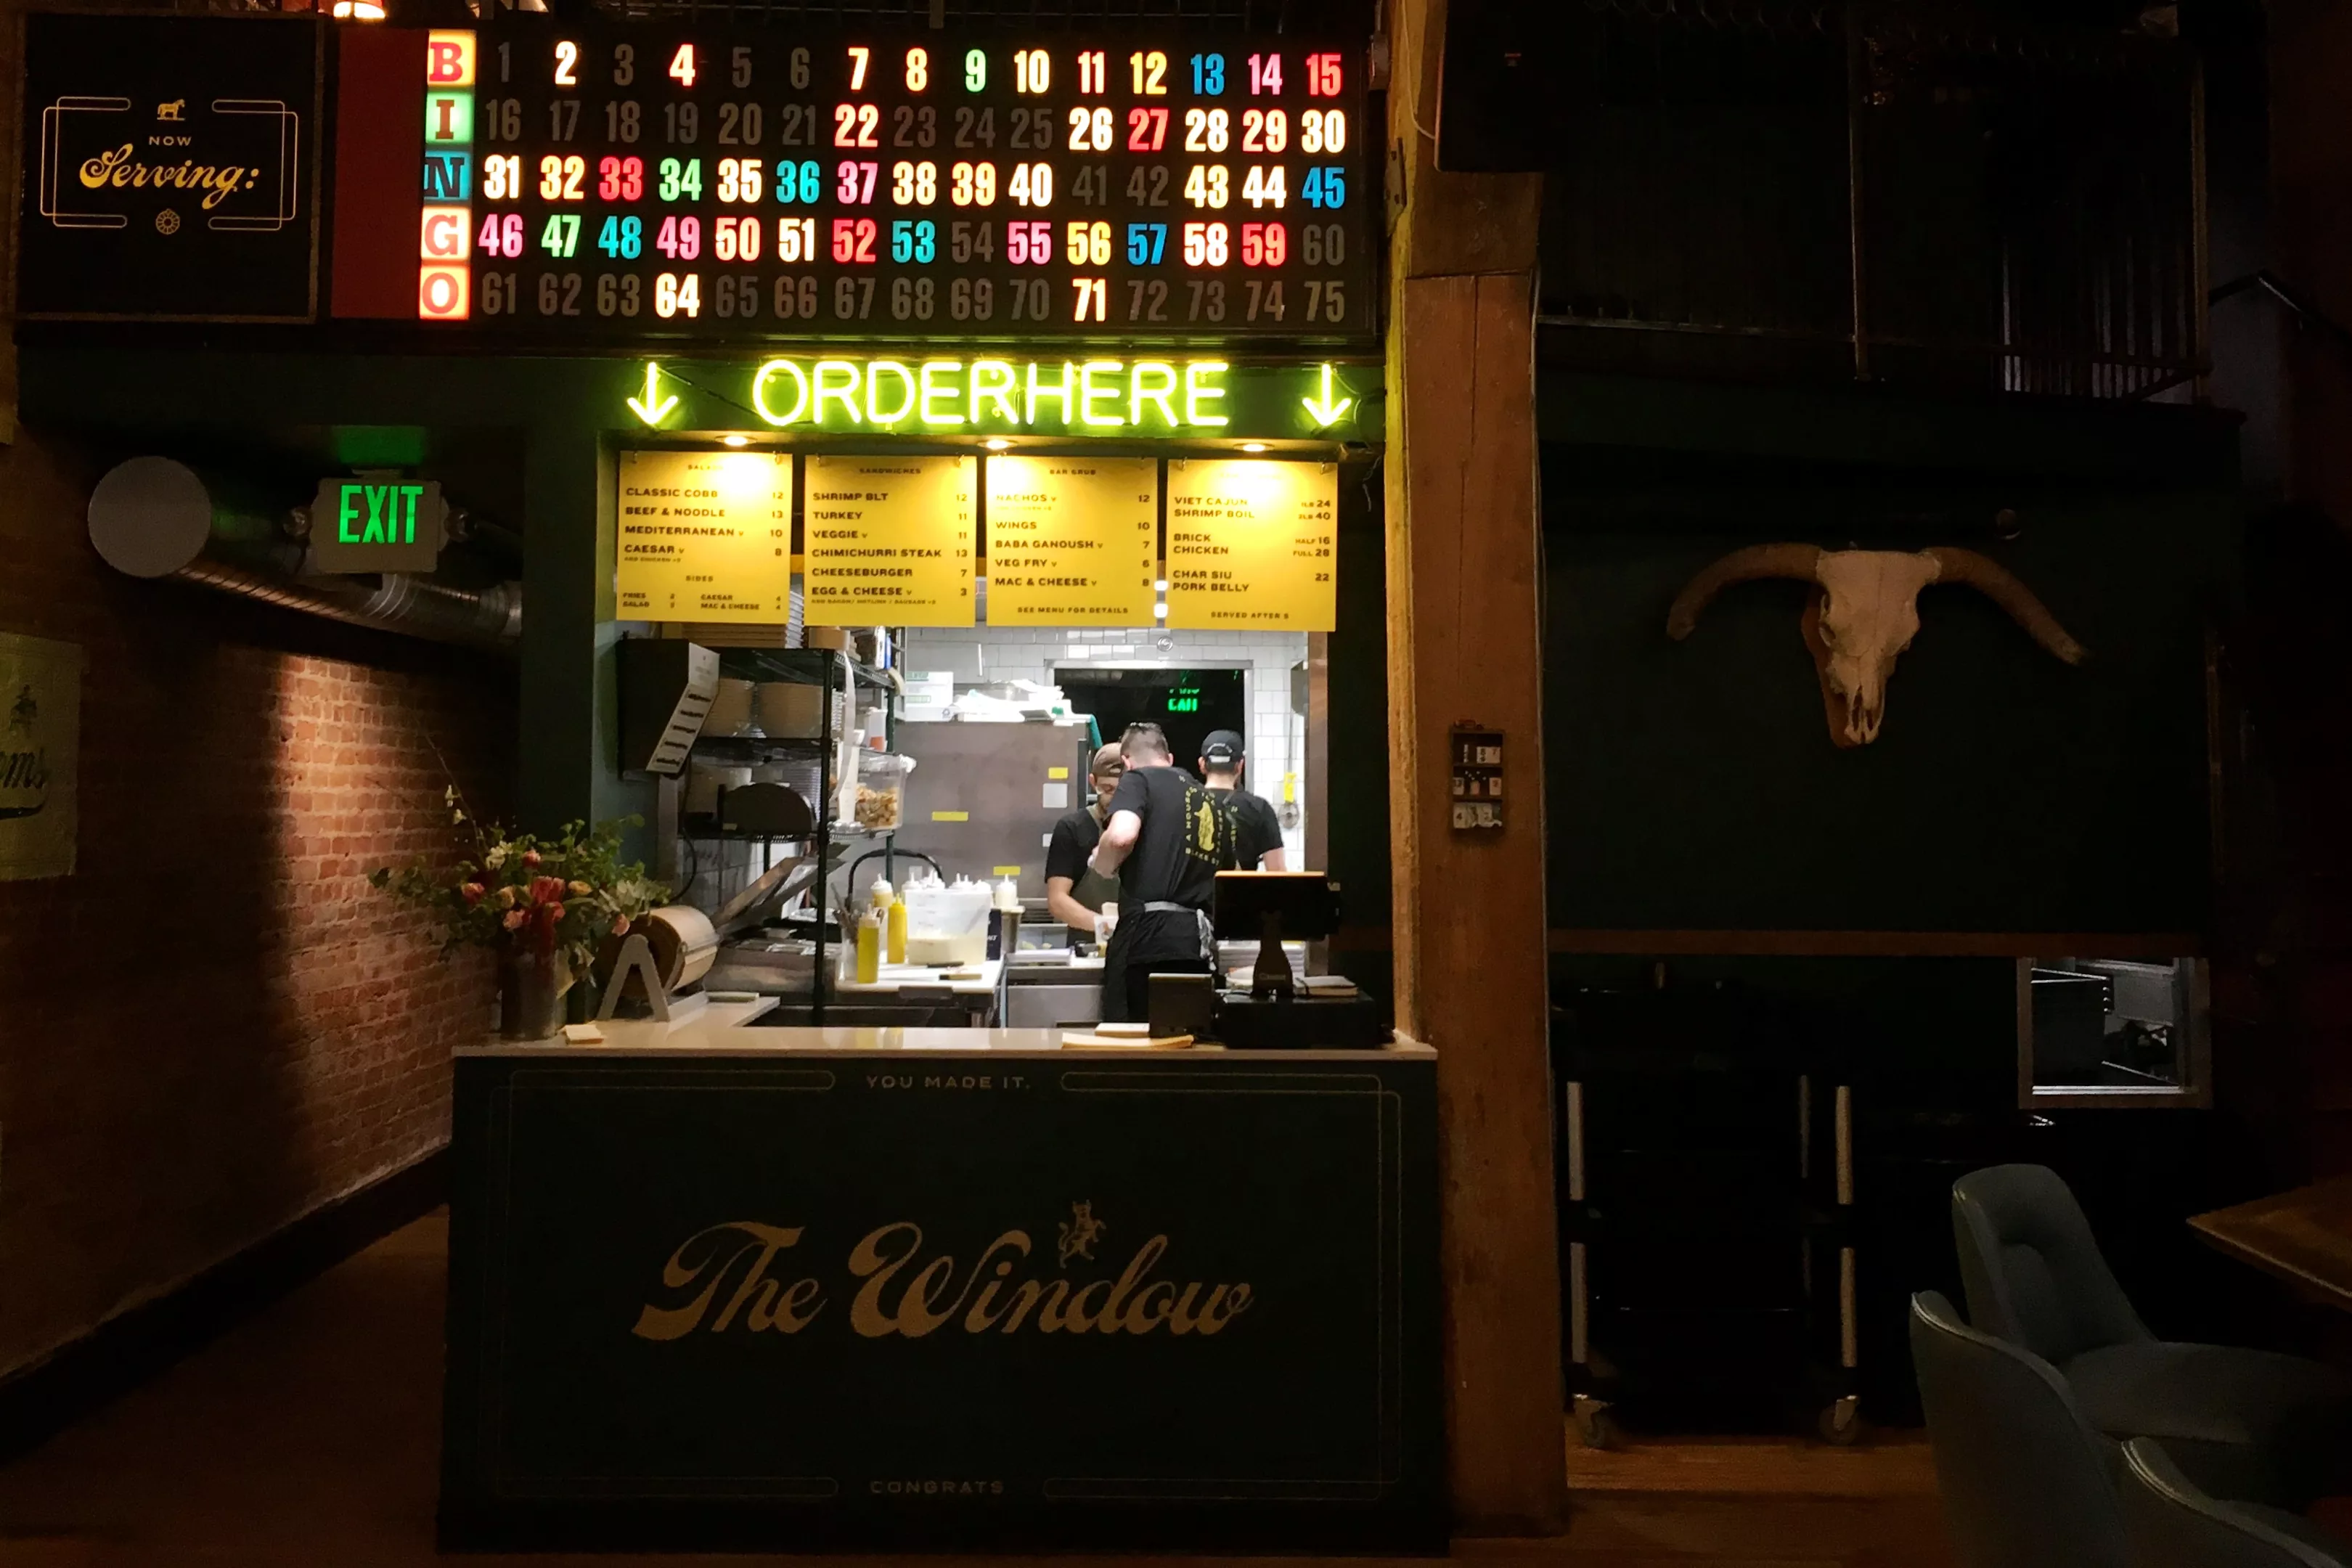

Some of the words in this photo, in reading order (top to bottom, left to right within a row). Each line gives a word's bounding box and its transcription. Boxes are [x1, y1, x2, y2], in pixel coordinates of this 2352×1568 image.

[555, 41, 578, 86] 2
[669, 43, 696, 87] 4
[848, 46, 870, 91] 7
[905, 47, 928, 92] 8
[965, 49, 986, 92] 9
[1013, 49, 1050, 94] 10
[1077, 51, 1105, 94] 11
[1130, 51, 1167, 95] 12
[1191, 54, 1225, 95] 13
[1248, 54, 1283, 95] 14
[1306, 53, 1342, 97] 15
[718, 102, 762, 146] 20
[834, 103, 879, 148] 22
[1069, 106, 1114, 151] 26
[1128, 107, 1169, 152] 27
[1185, 108, 1229, 152] 28
[1242, 108, 1287, 153] 29
[1301, 109, 1346, 153] 30
[149, 136, 192, 146] NOW
[79, 143, 259, 210] Serving:
[483, 154, 520, 200] 31
[539, 155, 586, 200] 32
[599, 156, 643, 201] 33
[659, 158, 702, 201] 34
[717, 158, 762, 203] 35
[777, 160, 820, 203] 36
[837, 160, 878, 204] 37
[892, 160, 936, 205] 38
[951, 161, 997, 207] 39
[1008, 162, 1053, 208] 40
[1126, 165, 1169, 206] 42
[1184, 164, 1229, 209] 43
[1242, 165, 1287, 208] 44
[1302, 168, 1344, 208] 45
[478, 213, 523, 258] 46
[541, 215, 581, 258] 47
[598, 216, 641, 258] 48
[656, 216, 701, 260] 49
[715, 216, 761, 262] 50
[778, 218, 815, 263] 51
[832, 218, 877, 263] 52
[893, 221, 935, 263] 53
[1008, 221, 1051, 265] 55
[1067, 221, 1111, 266] 56
[1128, 224, 1167, 265] 57
[1183, 221, 1229, 267] 58
[1242, 222, 1286, 267] 59
[655, 272, 701, 318] 64
[1072, 277, 1106, 322] 71
[626, 488, 679, 497] CLASSIC
[684, 489, 719, 498] COBB
[772, 491, 784, 499] 12
[813, 492, 862, 501] SHRIMP
[865, 492, 889, 501] BLT
[996, 494, 1047, 502] NACHOS
[1175, 497, 1202, 505] VIET
[1317, 499, 1331, 508] 24
[339, 485, 423, 544] EXIT
[626, 507, 658, 515] BEEF
[661, 507, 669, 515] &
[674, 508, 725, 517] NOODLE
[772, 510, 783, 518] 13
[813, 511, 862, 520] TURKEY
[1175, 508, 1222, 517] SHRIMP
[1227, 510, 1254, 518] BOIL
[996, 521, 1037, 530] WINGS
[1138, 521, 1150, 530] 10
[624, 526, 735, 536] MEDITERRANEAN
[813, 530, 858, 539] VEGGIE
[1173, 534, 1211, 542] BRICK
[1318, 536, 1330, 544] 16
[624, 544, 675, 554] CAESAR
[995, 540, 1028, 549] BABA
[1032, 540, 1094, 549] GANOUSH
[812, 549, 897, 558] CHIMICHURRI
[900, 549, 942, 558] STEAK
[955, 549, 968, 558] 13
[1173, 546, 1228, 555] CHICKEN
[995, 559, 1019, 568] VEG
[1024, 559, 1048, 568] FRY
[812, 568, 913, 576] CHEESEBURGER
[1173, 570, 1208, 579] CHAR
[1211, 571, 1233, 579] SIU
[995, 578, 1022, 587] MAC
[1026, 578, 1034, 587] &
[1038, 578, 1087, 587] CHEESE
[1143, 578, 1149, 587] 8
[1172, 582, 1206, 591] PORK
[1211, 583, 1250, 592] BELLY
[812, 587, 837, 595] EGG
[841, 587, 849, 595] &
[853, 587, 903, 596] CHEESE
[960, 588, 967, 597] 3
[865, 1075, 913, 1089] YOU
[925, 1076, 992, 1089] MADE
[630, 1221, 828, 1340] The
[847, 1221, 1255, 1340] Window
[869, 1479, 1004, 1495] CONGRATS
